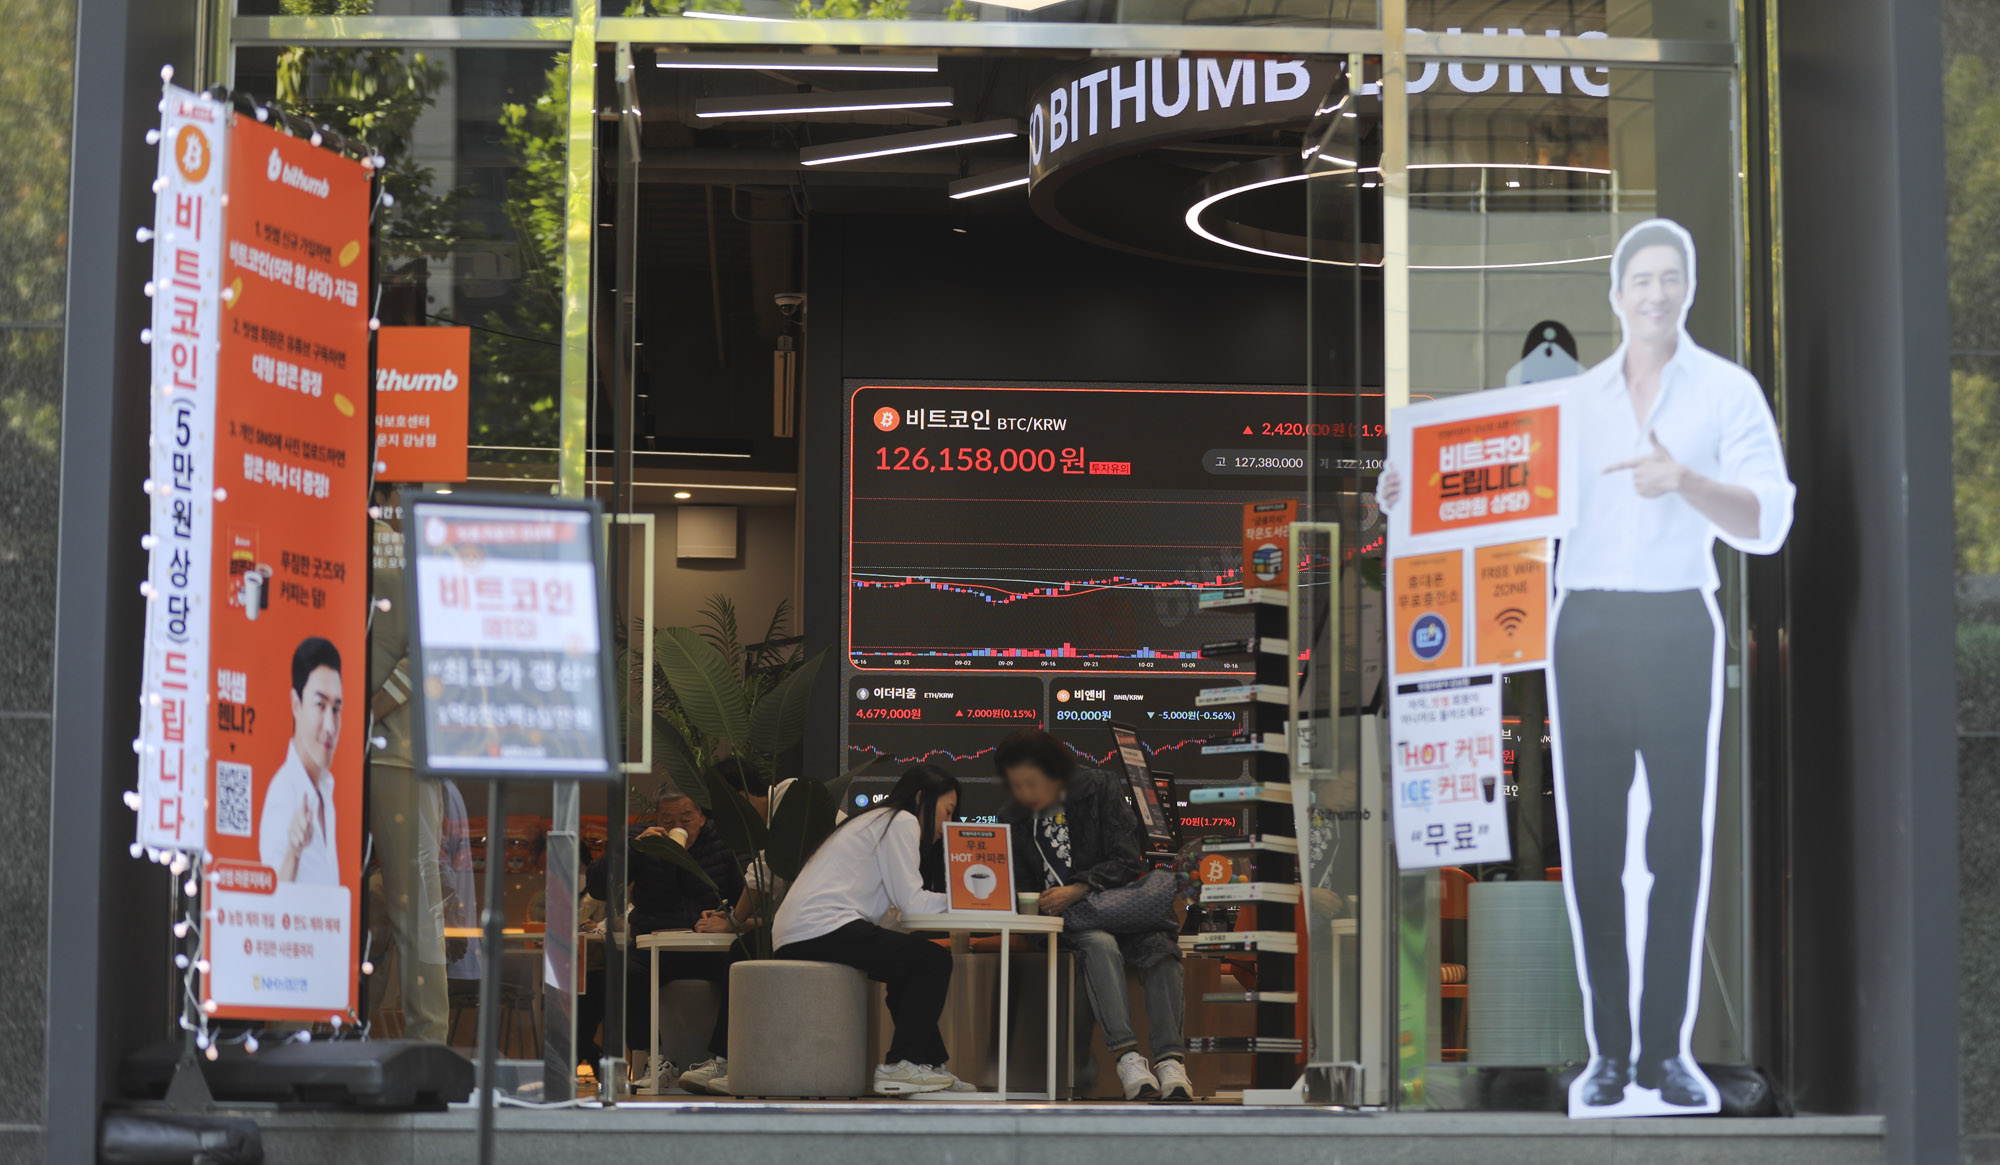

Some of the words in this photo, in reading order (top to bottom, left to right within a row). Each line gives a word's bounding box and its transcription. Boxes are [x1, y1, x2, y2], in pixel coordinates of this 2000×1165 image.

[1050, 57, 1310, 153] BITHUMB
[282, 161, 330, 199] bithumb
[335, 277, 358, 307] 지급
[906, 408, 990, 430] 비트코인
[997, 418, 1067, 432] BTC/KRW
[1215, 457, 1226, 467] 고
[1234, 457, 1303, 469] 127,380,000
[1439, 433, 1531, 473] 비트코인
[265, 460, 288, 490] 하나
[289, 466, 301, 493] 더
[1090, 463, 1131, 474] 투자유의
[1440, 463, 1530, 498] 드립니다
[1481, 565, 1509, 580] FREE
[439, 574, 574, 615] 비트코인
[1494, 580, 1527, 598] ZONE
[217, 667, 247, 704] 빗썸
[873, 688, 916, 700] 이더리움
[1074, 689, 1106, 701] 비앤비
[856, 708, 921, 720] 4,679,000원
[967, 708, 1036, 719] 7,000원(0.15%)
[1056, 710, 1111, 722] 890,000원
[1158, 711, 1236, 722] -5,000원(-0.56%)
[1405, 742, 1449, 766] HOT
[1455, 735, 1494, 760] 커피
[1401, 779, 1431, 801] ICE
[1438, 773, 1477, 799] 커피
[1180, 817, 1236, 828] 70원(1.77%)
[967, 841, 986, 850] 무료
[951, 853, 972, 862] HOT
